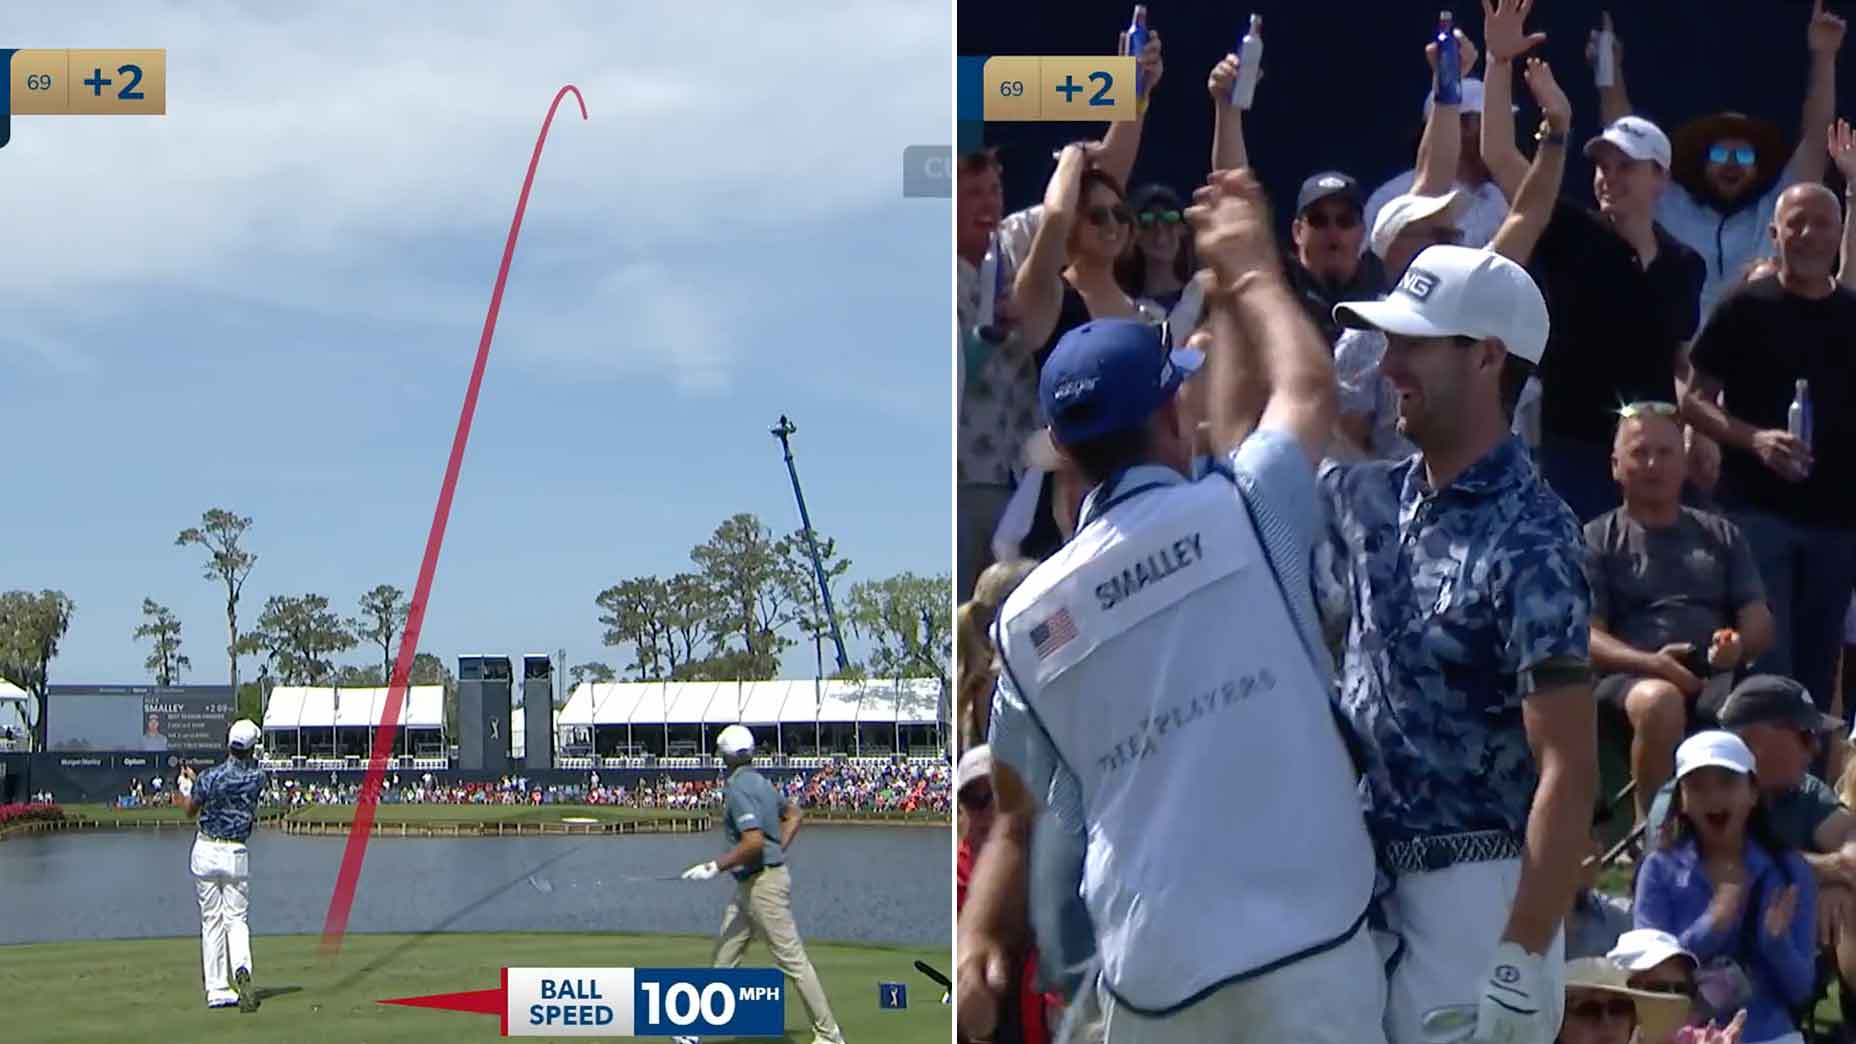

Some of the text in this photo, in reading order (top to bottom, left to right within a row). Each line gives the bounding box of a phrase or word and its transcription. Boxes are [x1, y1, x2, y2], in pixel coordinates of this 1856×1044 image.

[1095, 532, 1204, 611] SMALLEY
[144, 704, 184, 713] SMALLEY
[1154, 668, 1278, 735] PLAYERS
